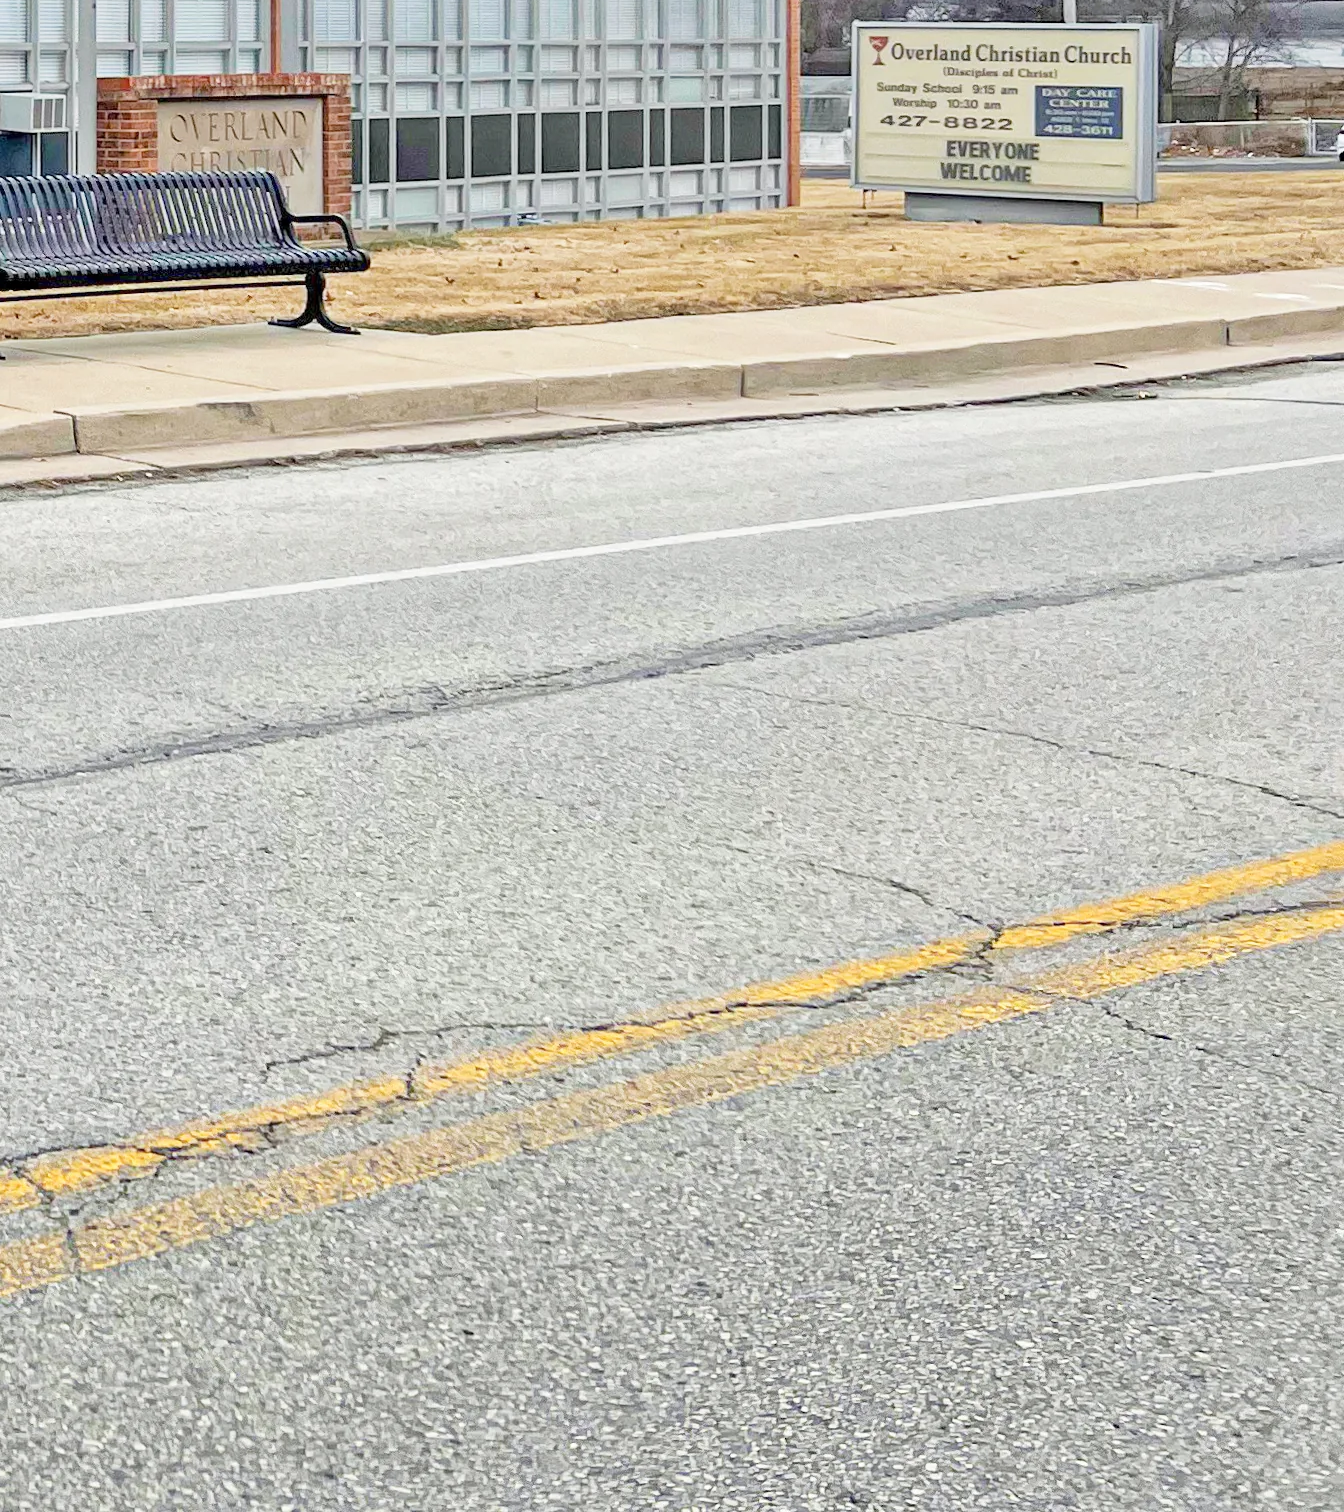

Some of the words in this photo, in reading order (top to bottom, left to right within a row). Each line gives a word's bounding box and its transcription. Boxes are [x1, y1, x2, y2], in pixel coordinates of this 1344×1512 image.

[891, 42, 972, 62] Overland
[975, 44, 1060, 64] Christian
[1064, 45, 1132, 65] Church
[943, 66, 999, 79] (Disciples
[1002, 68, 1014, 78] of
[876, 82, 917, 95] Sunday
[922, 83, 963, 94] School
[972, 84, 996, 95] 9:15
[1000, 86, 1019, 95] am
[1041, 88, 1071, 97] DAY
[1076, 89, 1118, 99] CARE
[892, 97, 938, 110] Worship
[947, 99, 979, 110] 10:30
[983, 102, 1002, 110] am
[1048, 98, 1110, 109] CENTER
[169, 110, 308, 143] OVERLAND
[880, 114, 1014, 131] 427-8822
[946, 140, 1040, 161] EVERYONE
[940, 162, 1032, 183] WELCOME
